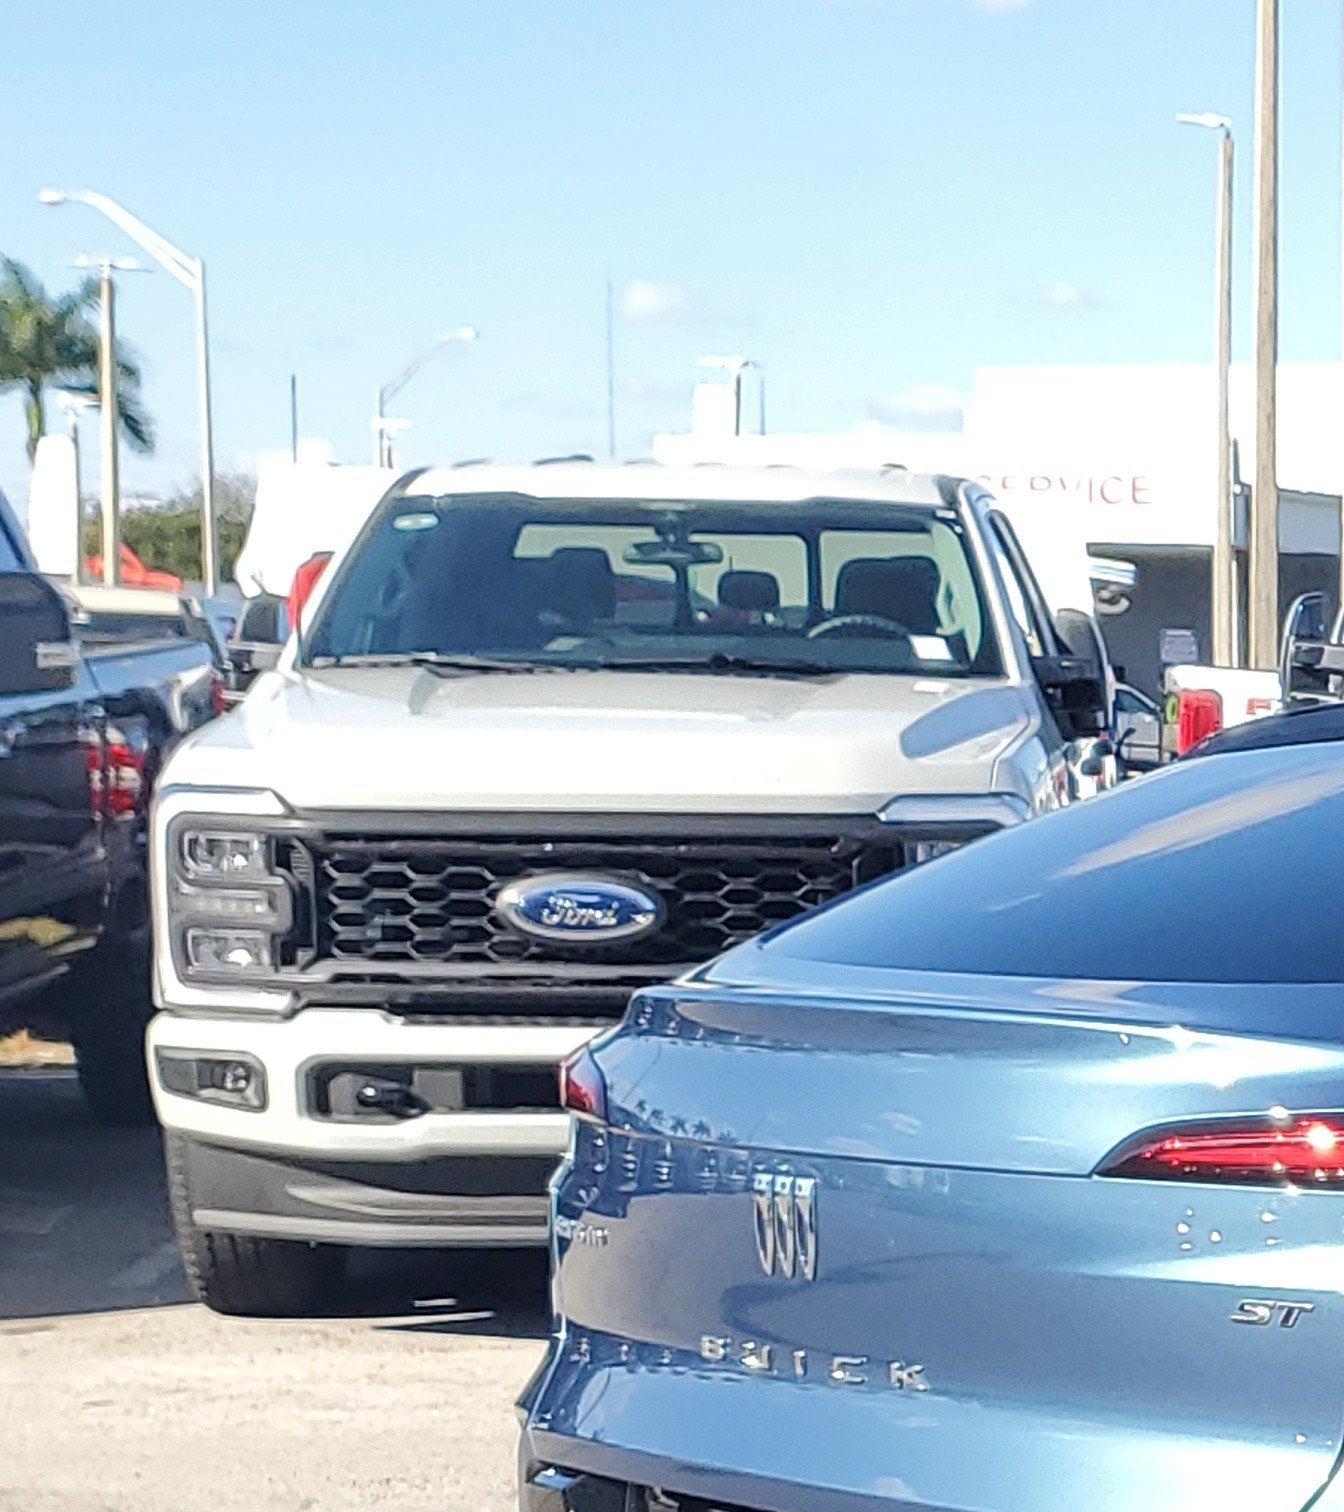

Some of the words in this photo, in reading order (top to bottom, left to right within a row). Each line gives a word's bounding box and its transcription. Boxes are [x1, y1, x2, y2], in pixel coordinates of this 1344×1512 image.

[975, 474, 1152, 505] ERVICE
[1230, 1298, 1315, 1329] ST
[700, 1334, 929, 1392] BUICK
